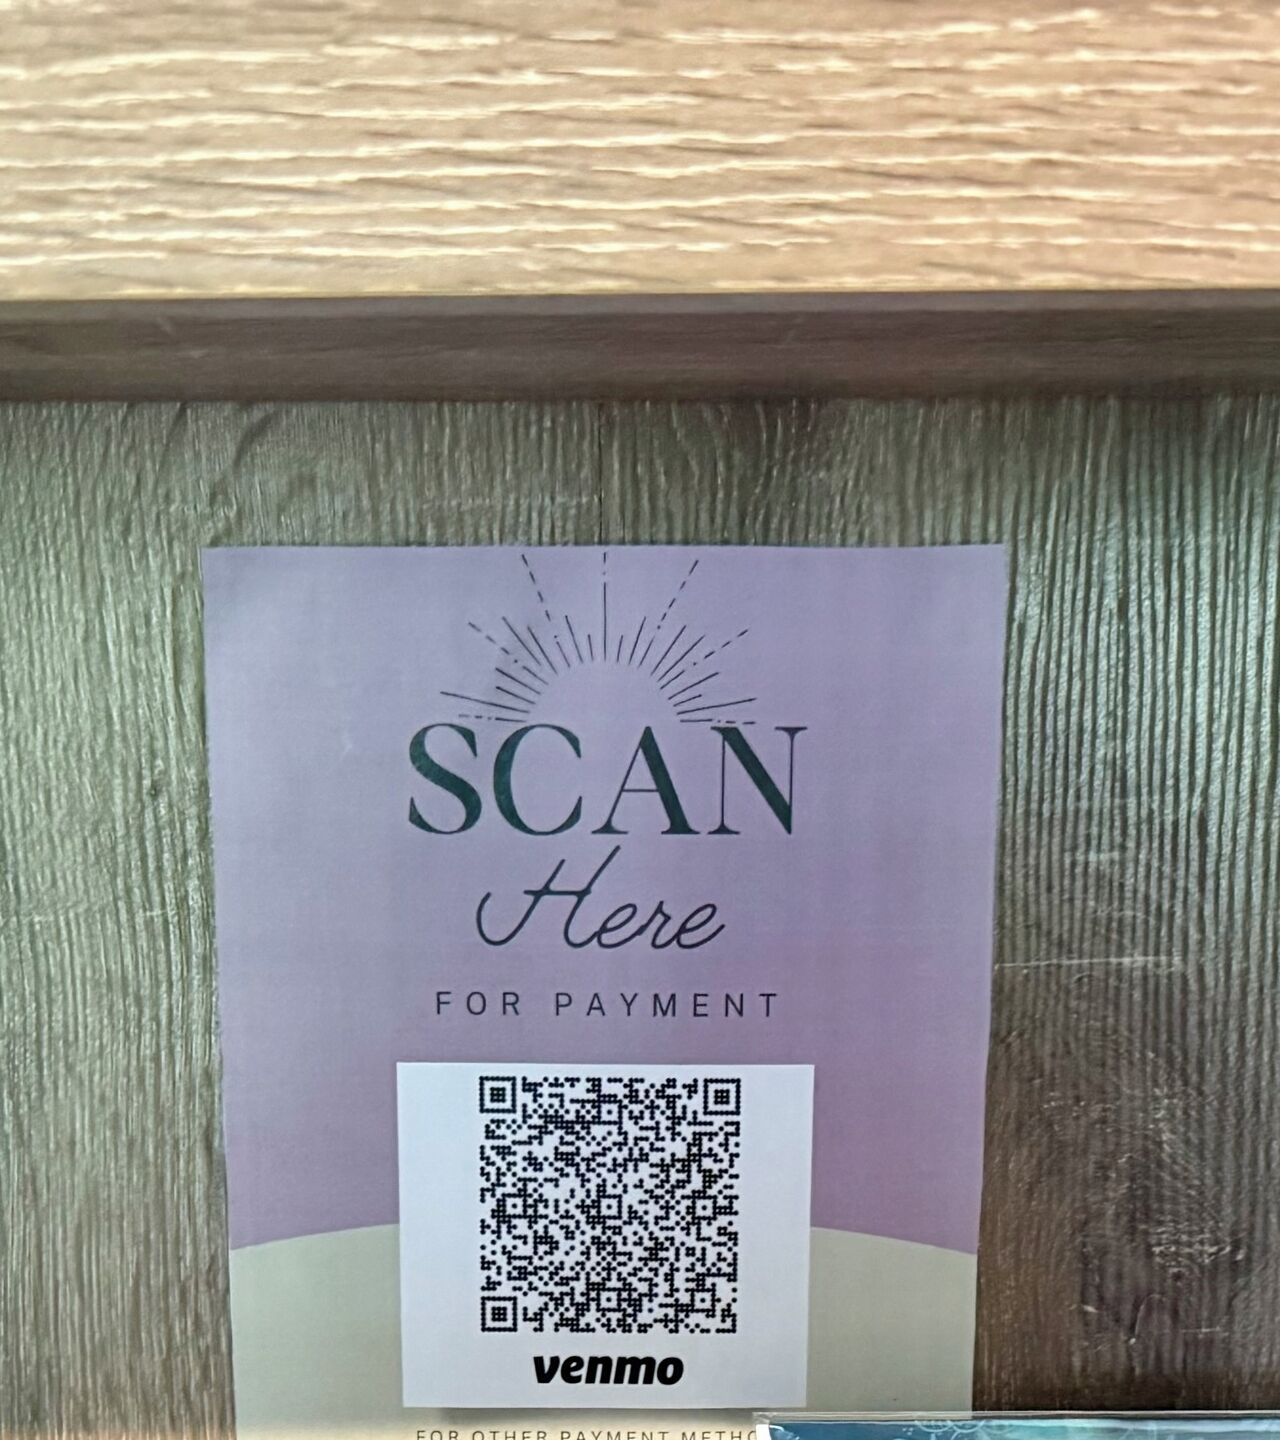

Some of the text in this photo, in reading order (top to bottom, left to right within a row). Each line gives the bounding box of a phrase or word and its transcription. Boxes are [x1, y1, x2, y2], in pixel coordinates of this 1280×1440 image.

[408, 723, 808, 835] SCAN
[476, 845, 726, 949] Here
[436, 991, 778, 1018] FOR PAYMENT
[533, 1355, 685, 1386] venmo
